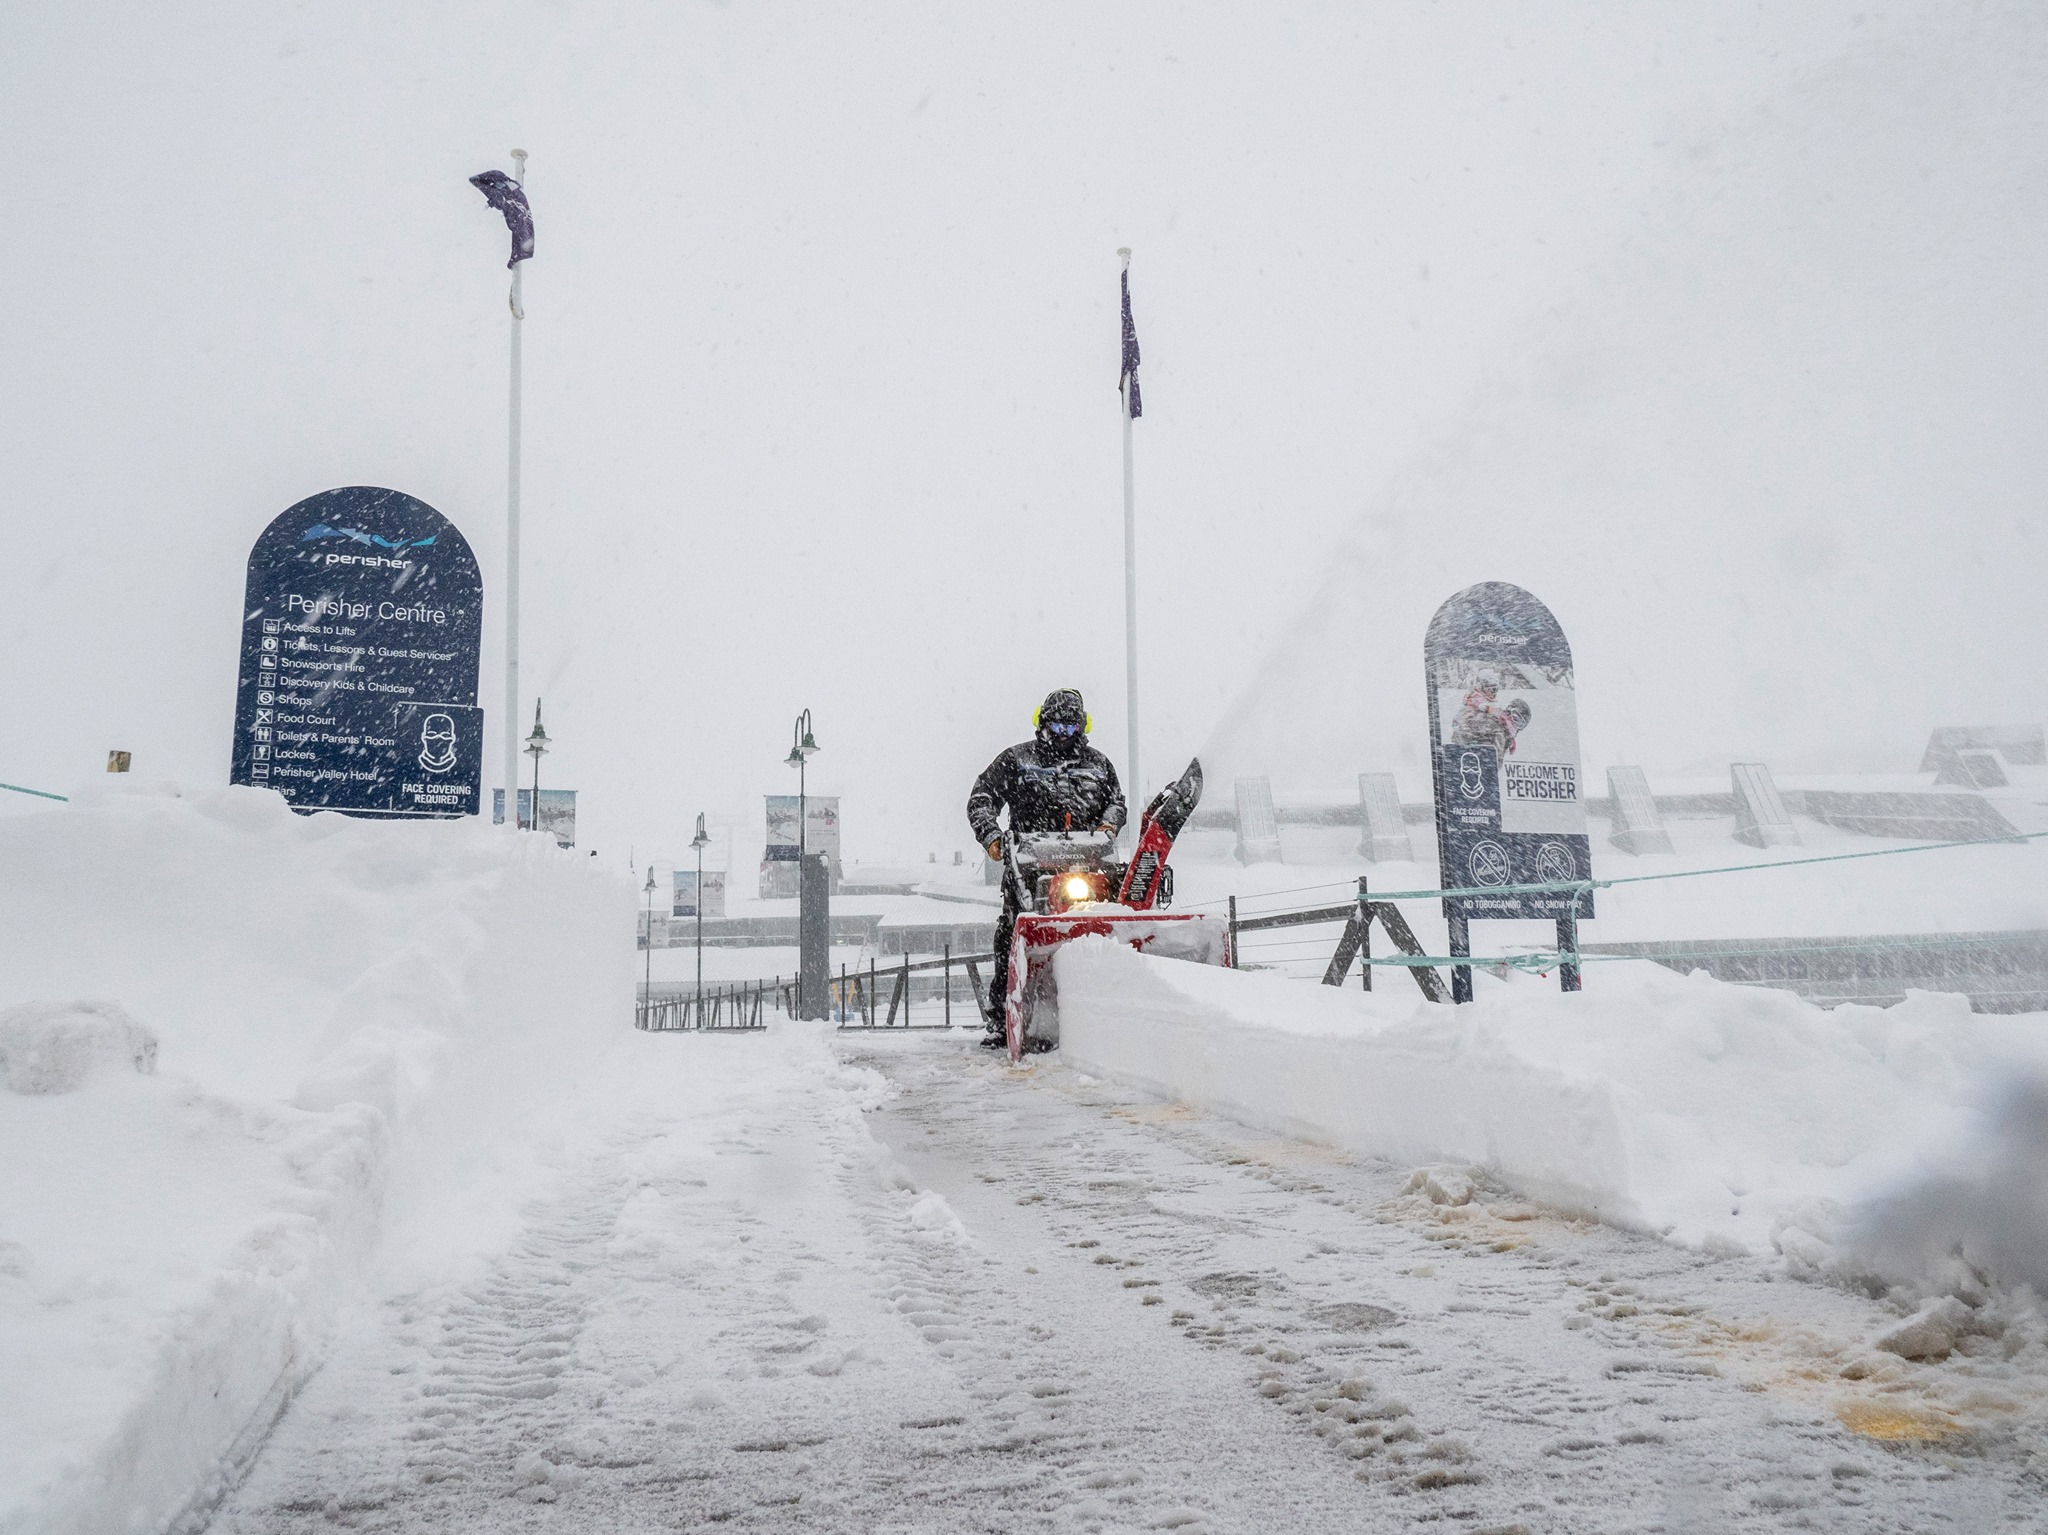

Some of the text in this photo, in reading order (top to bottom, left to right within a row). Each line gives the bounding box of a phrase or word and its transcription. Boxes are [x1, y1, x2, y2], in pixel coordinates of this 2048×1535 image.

[326, 554, 412, 569] perisher
[288, 594, 446, 624] Perisher Centre
[283, 622, 356, 637] Access to Lifts
[1479, 634, 1529, 645] perisher
[282, 639, 451, 661] Tickets, Lessons & Guest Services
[281, 657, 366, 673] Snowsports Hire
[279, 676, 415, 695] Discovery Kids & Childcare
[278, 695, 312, 707] Shops
[277, 712, 336, 726] Food Court
[276, 730, 395, 747] Toilets & Parents' Room
[274, 748, 316, 761] Lockers
[273, 766, 377, 782] Perisher Valley Hotel
[1504, 764, 1576, 781] WELCOME TO
[402, 783, 471, 796] FACE COVERING
[1506, 779, 1577, 799] PERISHER
[414, 794, 459, 805] REQUIRED
[1453, 808, 1496, 817] FACE COVERING
[1461, 816, 1489, 824] REQUIRED
[1463, 900, 1521, 909] NO TOBOGGANING
[1535, 900, 1582, 909] NO SNOW PAY
